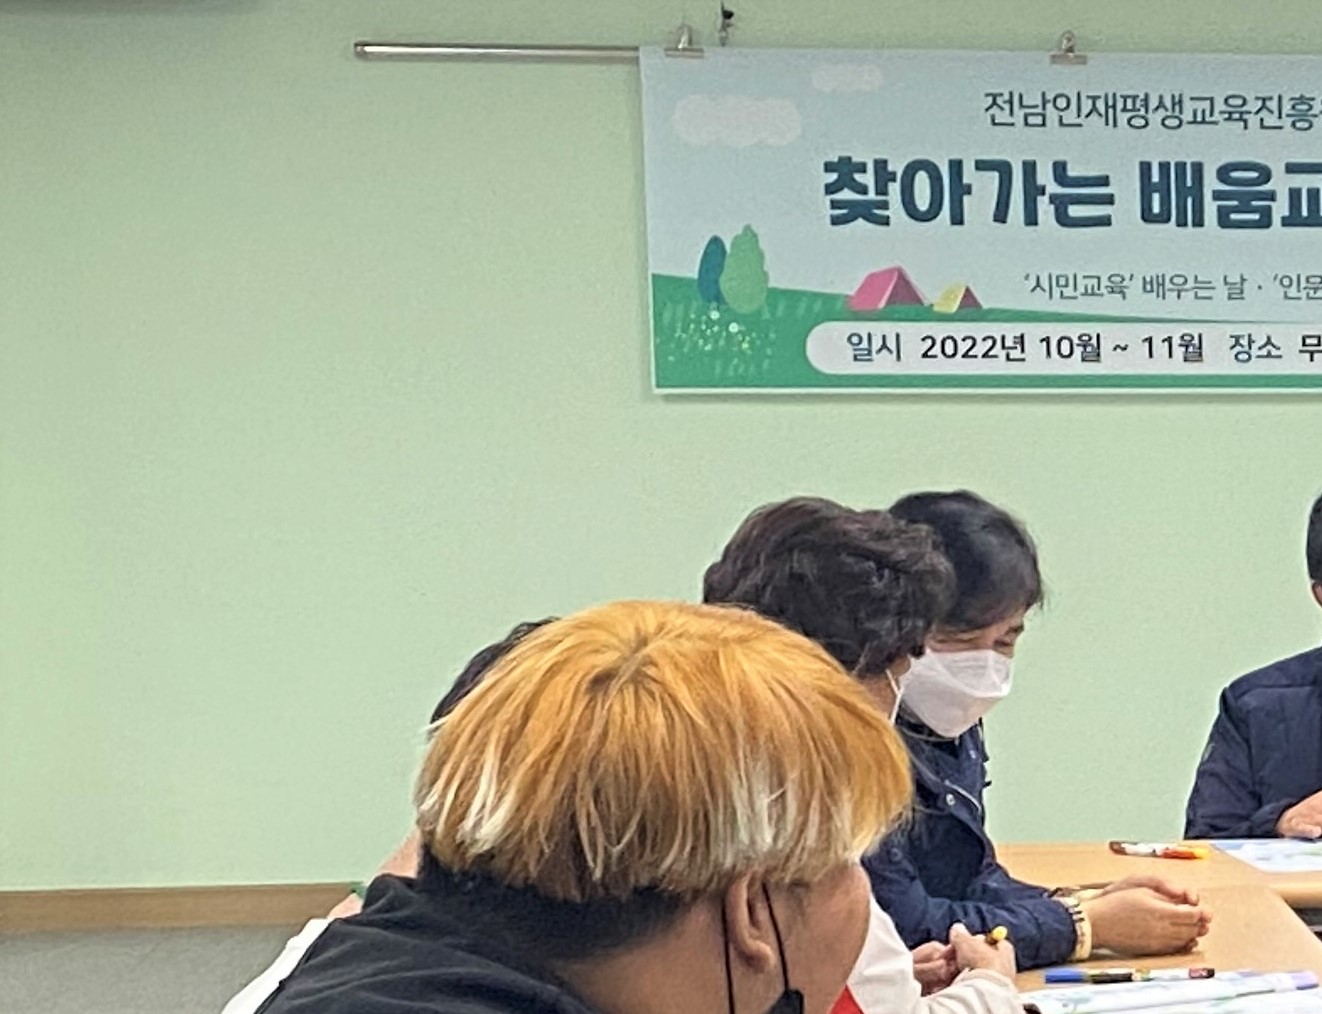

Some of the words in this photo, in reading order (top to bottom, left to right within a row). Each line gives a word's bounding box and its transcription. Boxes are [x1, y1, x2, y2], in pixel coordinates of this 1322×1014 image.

[823, 155, 1116, 229] 찾아가는
[1141, 273, 1217, 301] 배우는
[1223, 273, 1248, 301] 날
[846, 331, 902, 363] 일시
[920, 332, 1027, 362] 2022년
[1039, 332, 1101, 363] 10월
[1141, 332, 1204, 363] 11월
[1229, 333, 1283, 364] 장소
